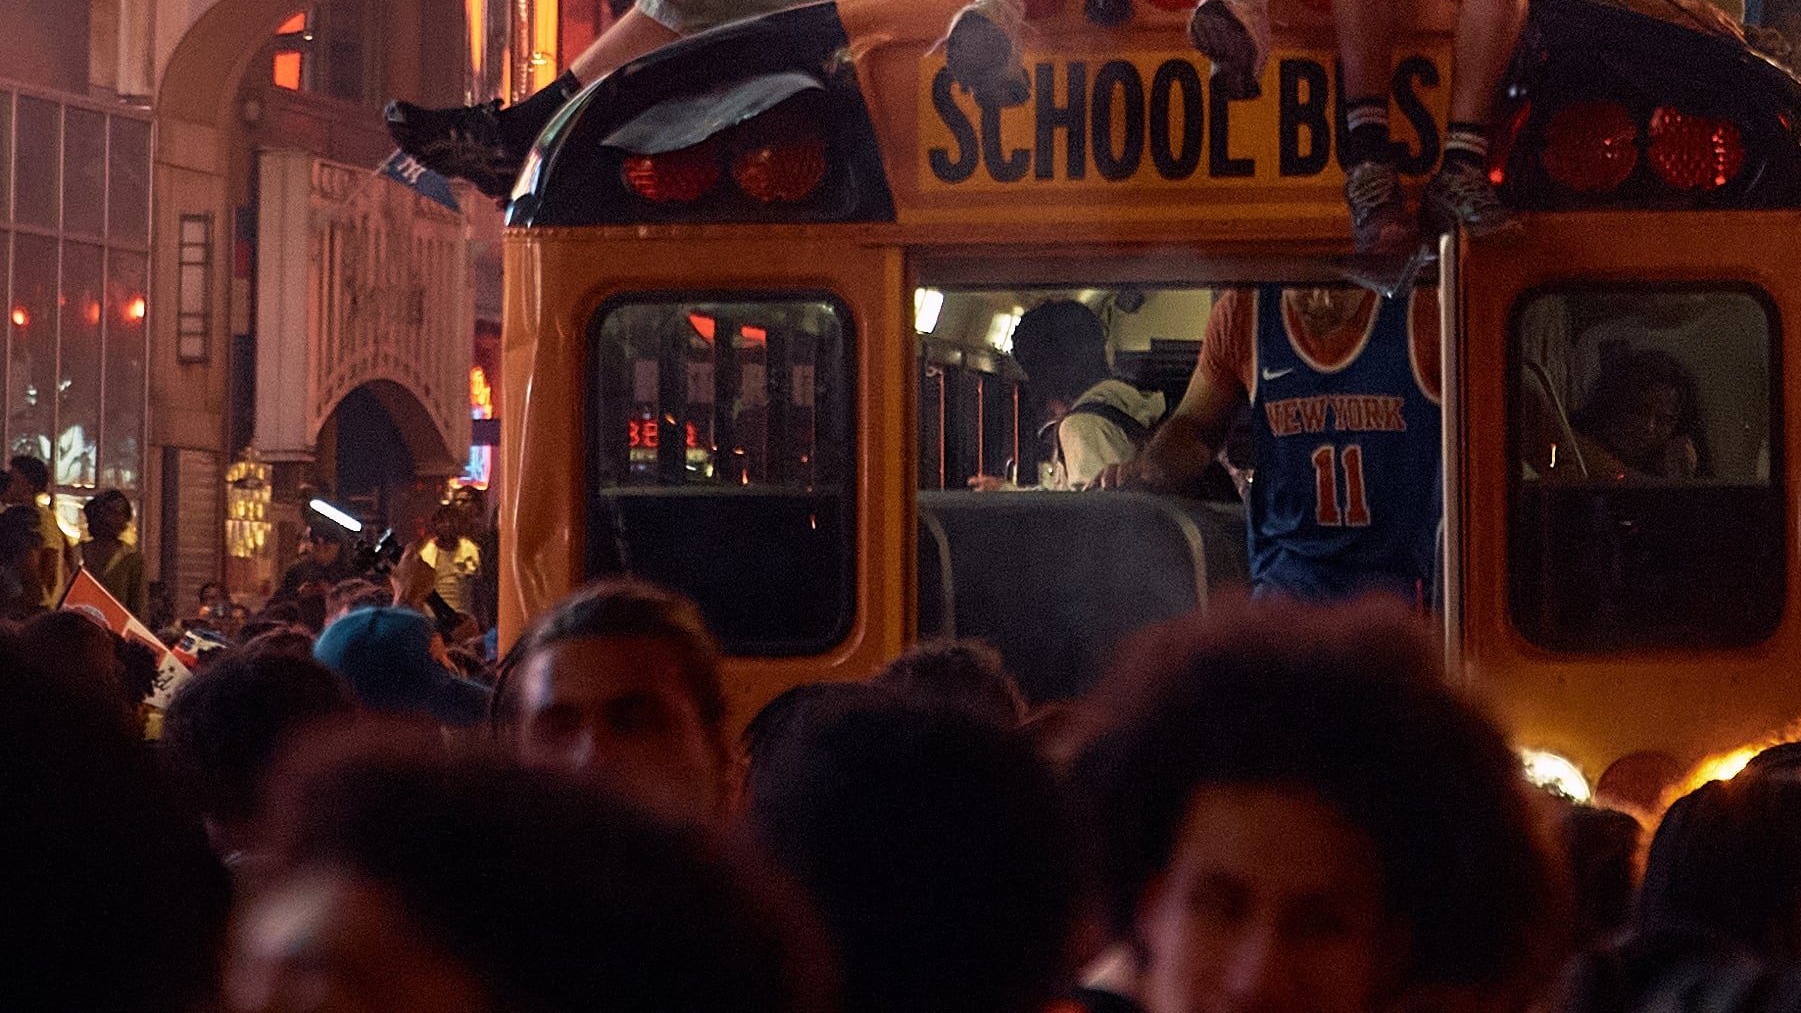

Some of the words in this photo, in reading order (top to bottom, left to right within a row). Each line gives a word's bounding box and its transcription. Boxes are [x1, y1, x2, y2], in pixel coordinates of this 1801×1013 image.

[928, 55, 1260, 183] SCHOOL
[1264, 398, 1328, 437] NEW
[1327, 394, 1407, 432] YORK
[1311, 443, 1372, 527] 11
